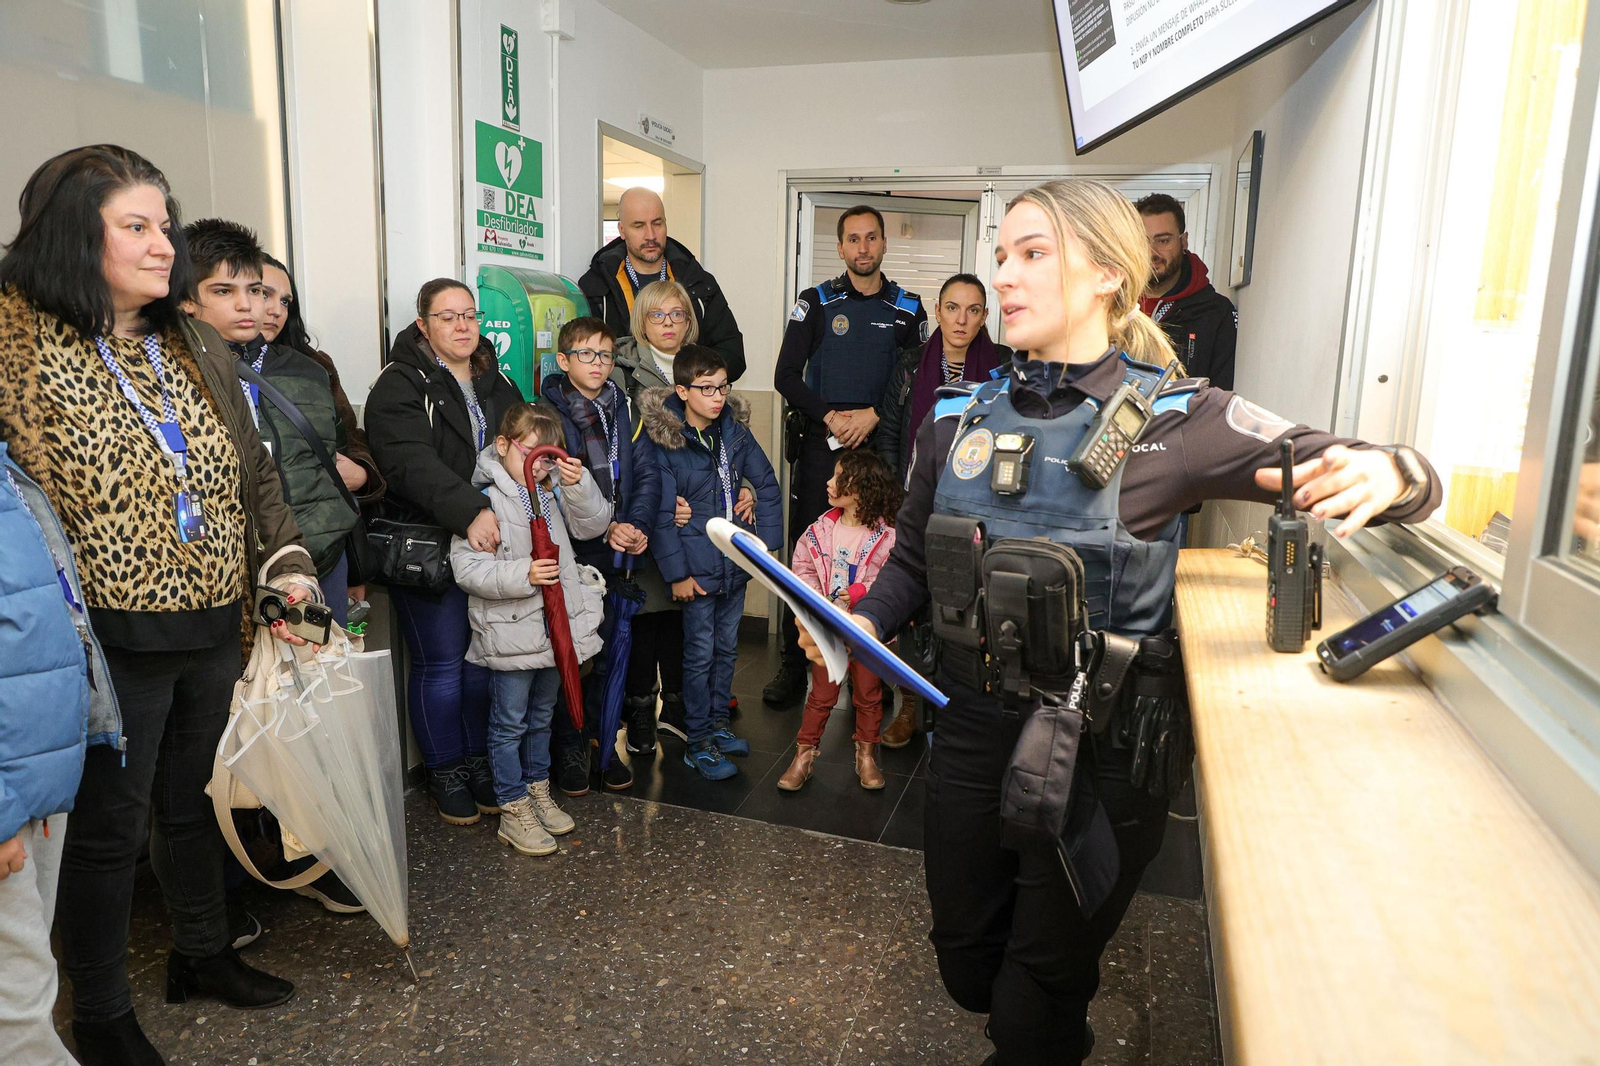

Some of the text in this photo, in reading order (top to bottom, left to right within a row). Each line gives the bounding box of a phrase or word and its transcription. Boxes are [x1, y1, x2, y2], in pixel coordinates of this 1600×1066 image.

[1132, 60, 1140, 70] TU
[1148, 50, 1153, 59] Y
[1152, 38, 1175, 57] NOMBRE
[1174, 15, 1204, 41] COMPLETO
[1204, 5, 1220, 22] PARA
[1135, 34, 1150, 52] ENVÍA
[1149, 29, 1158, 42] UN
[1158, 13, 1180, 35] MENSAJE
[1180, 7, 1189, 20] DE
[506, 56, 515, 105] DEA
[505, 190, 537, 221] DEA
[483, 212, 538, 236] Desfibrilador
[485, 320, 511, 329] AED
[1044, 456, 1069, 466] POLIC
[1131, 442, 1167, 453] OCAL
